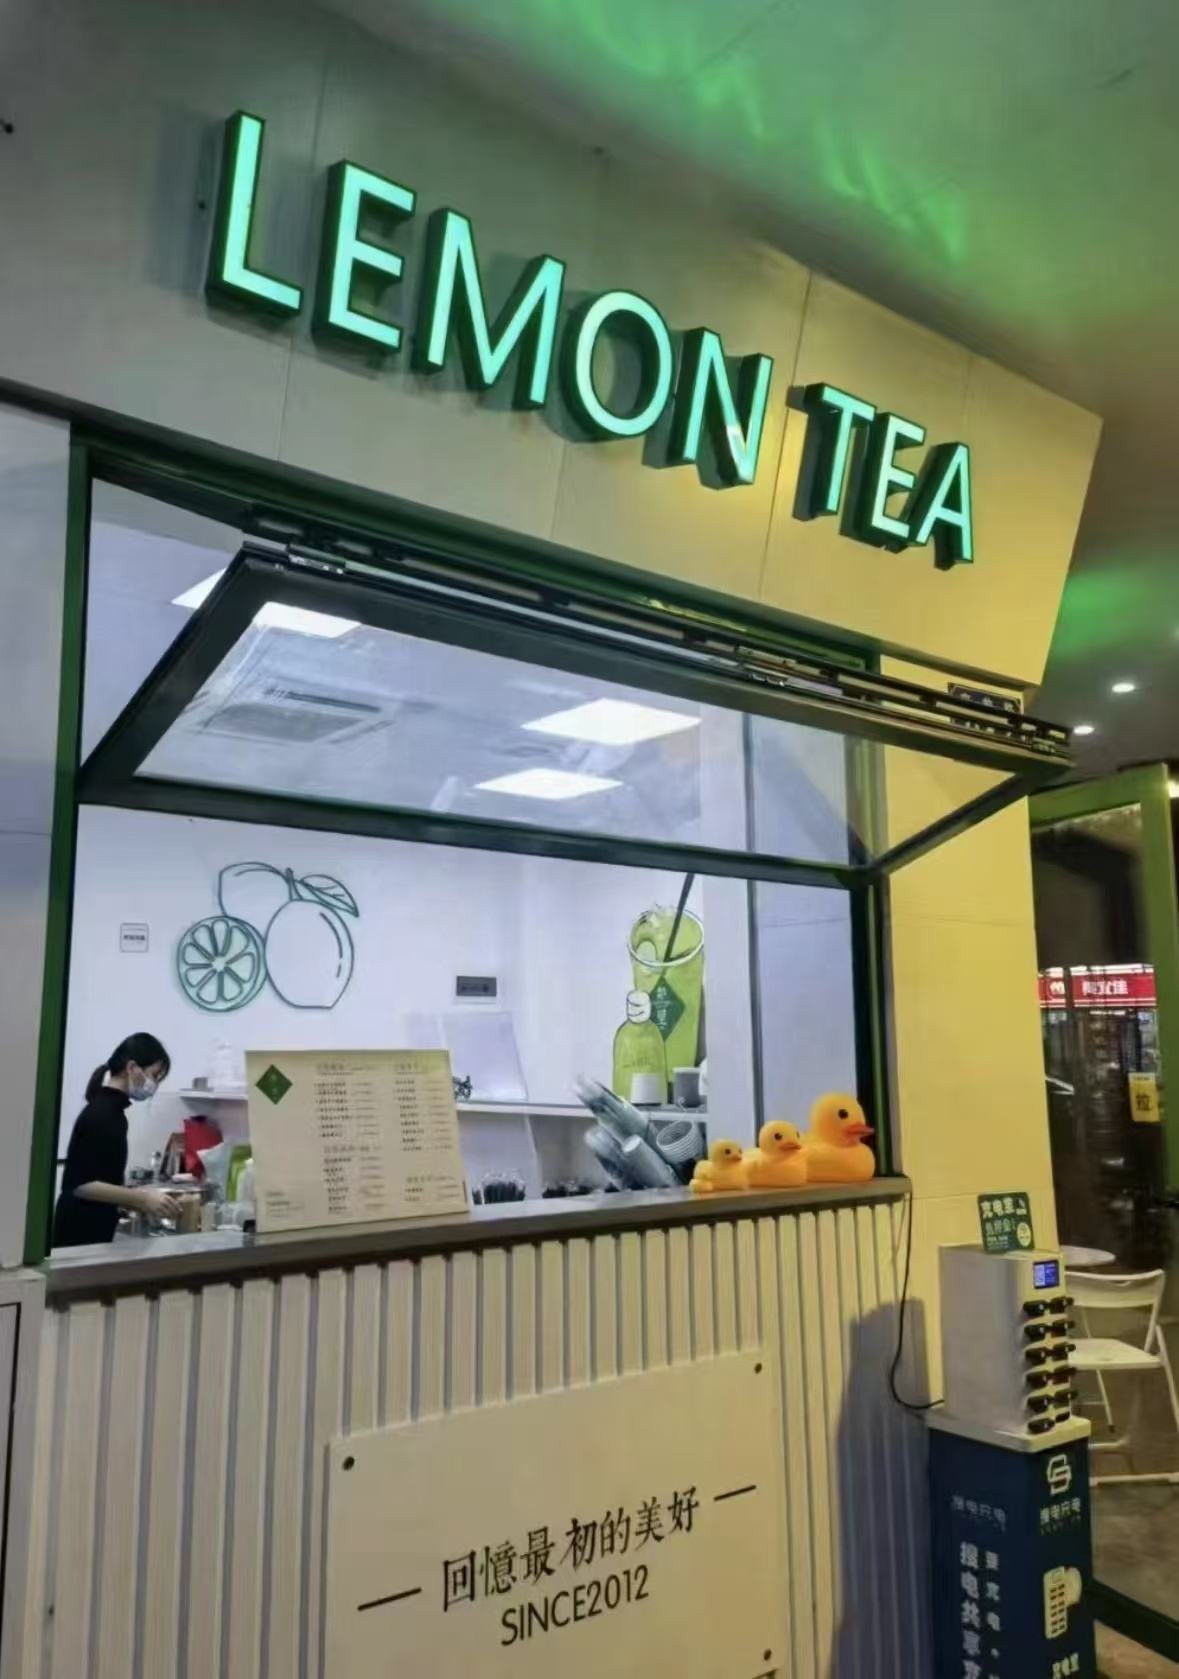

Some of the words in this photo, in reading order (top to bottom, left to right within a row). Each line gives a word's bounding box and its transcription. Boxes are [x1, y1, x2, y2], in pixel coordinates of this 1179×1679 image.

[209, 110, 774, 488] LEMON
[801, 382, 974, 570] TEA
[443, 1486, 700, 1612] 回憶最初的美好
[501, 1565, 650, 1646] SINCE2012
